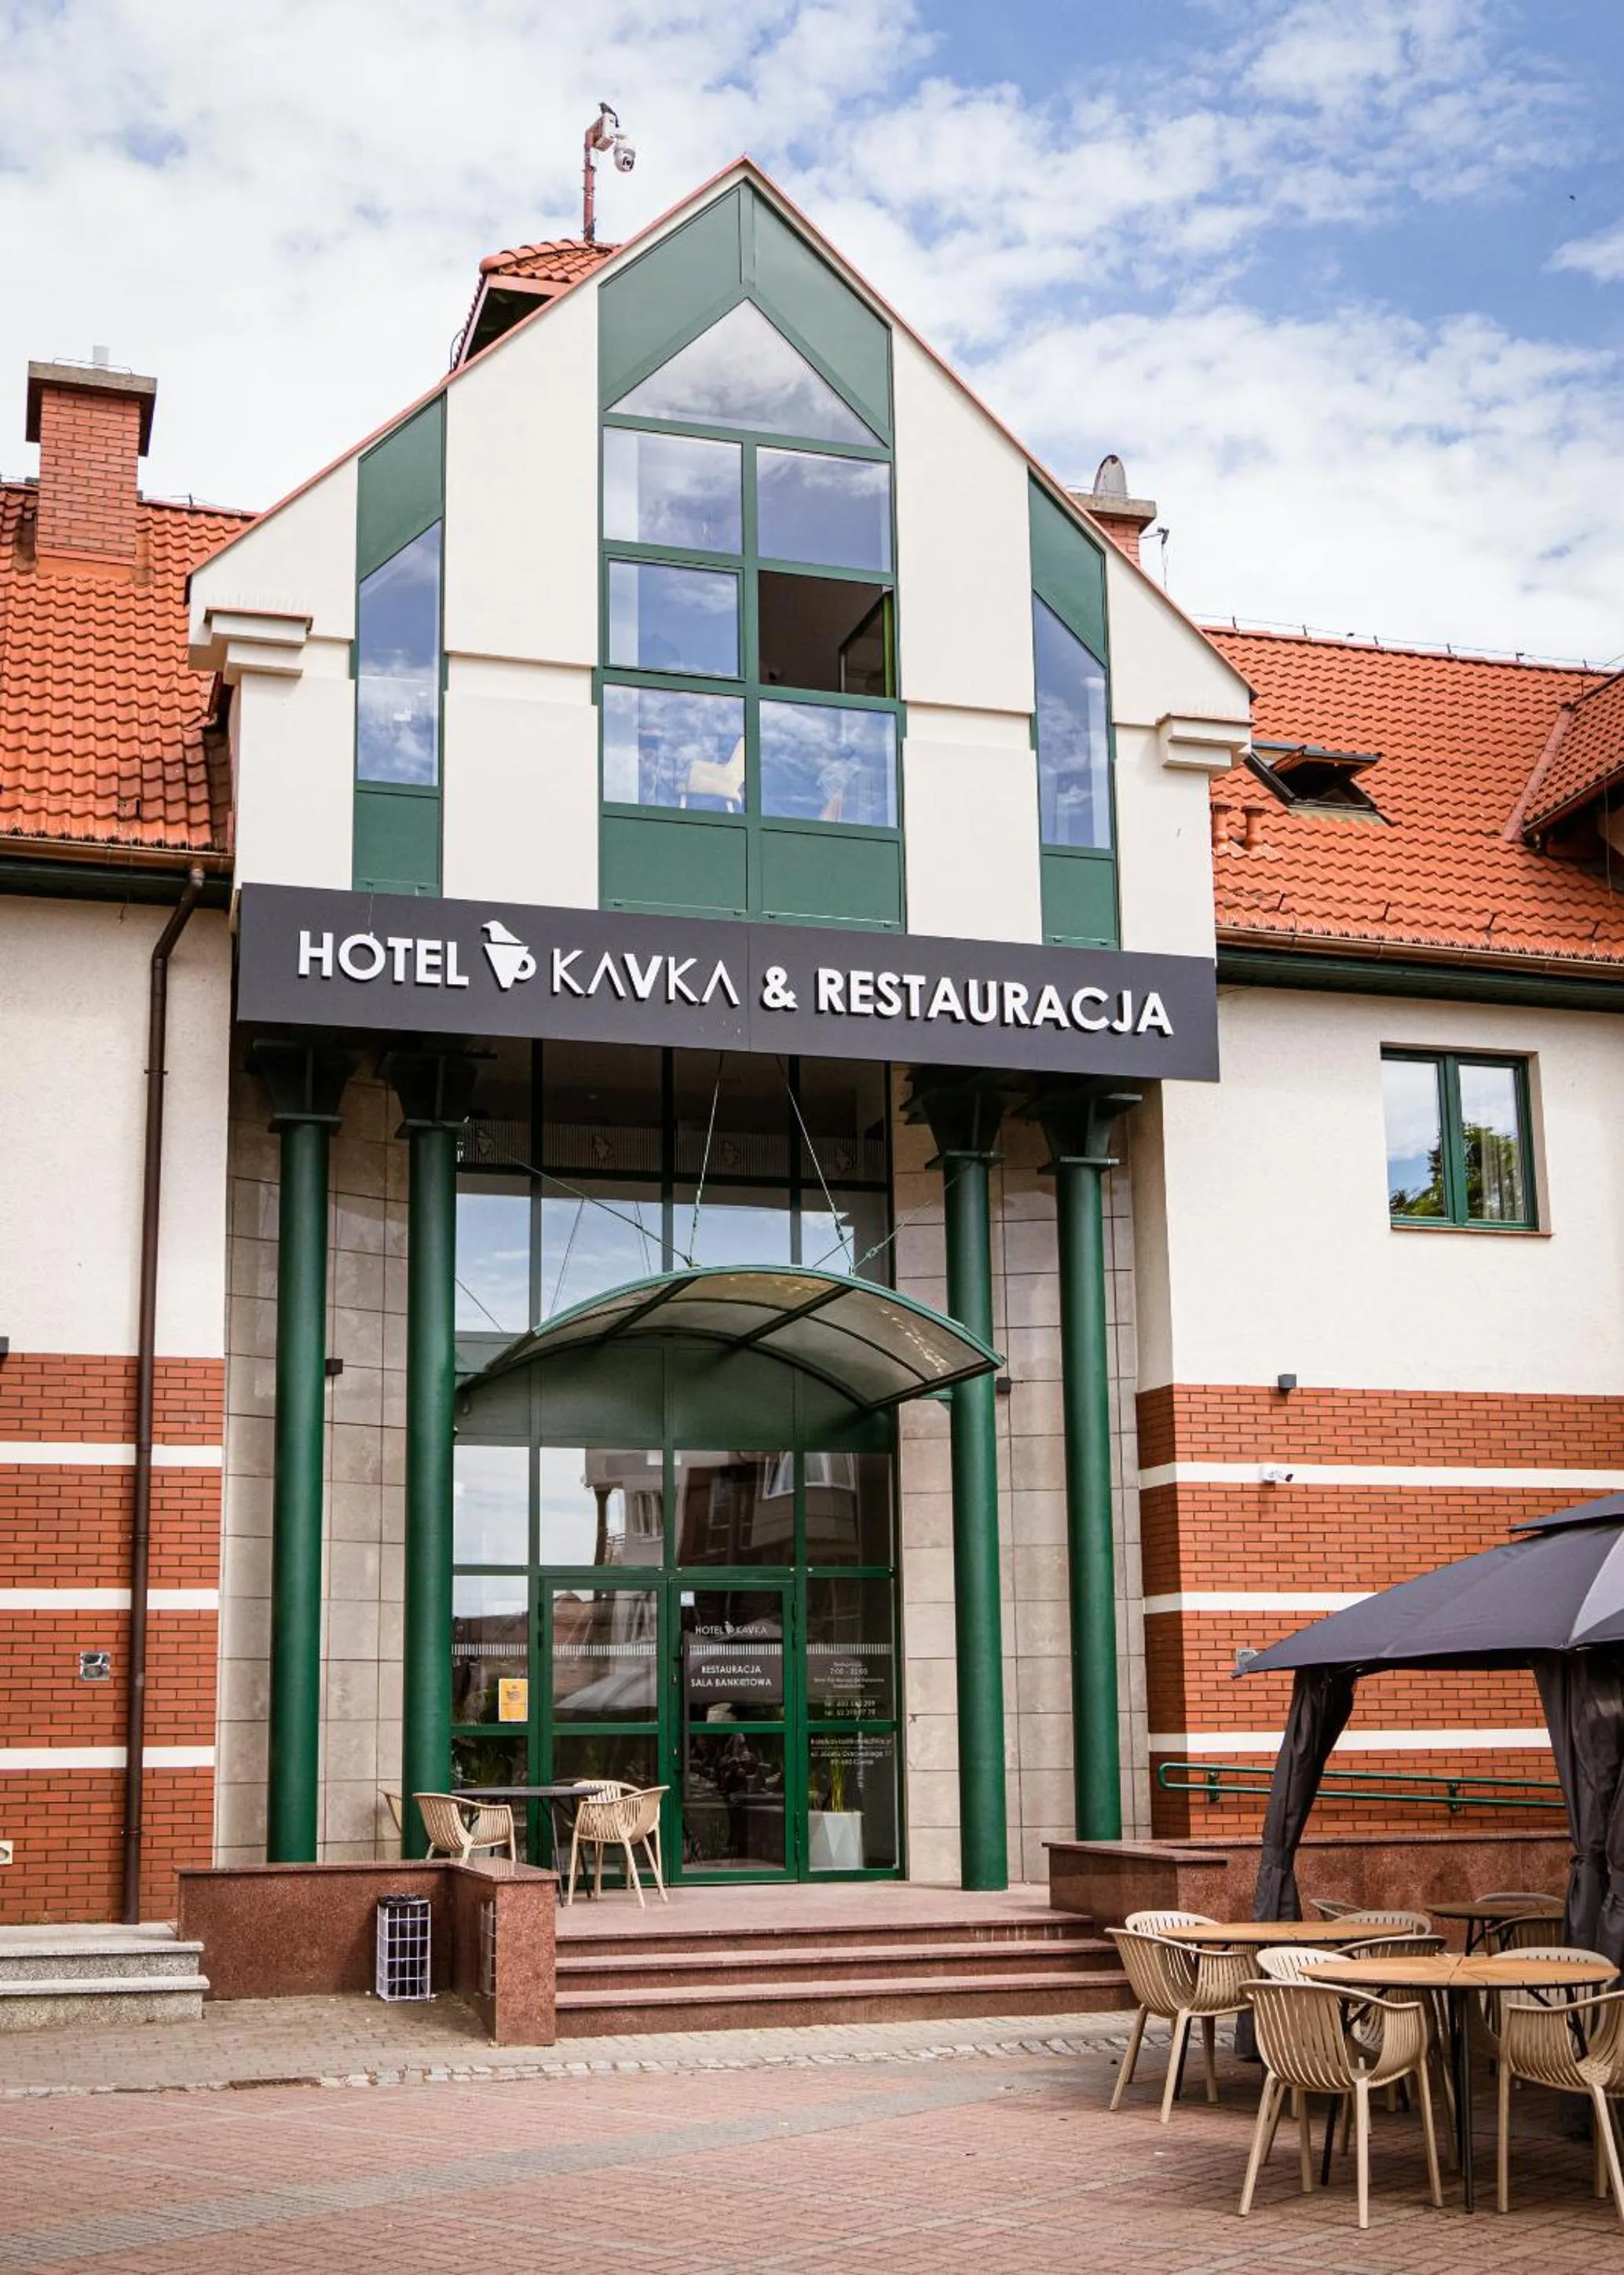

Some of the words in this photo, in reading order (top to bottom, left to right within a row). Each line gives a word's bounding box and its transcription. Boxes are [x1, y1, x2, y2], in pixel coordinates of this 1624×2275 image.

[297, 930, 470, 987] HOTEL
[760, 965, 799, 1010] &
[816, 967, 1175, 1037] RESTAURACJA
[695, 1625, 724, 1635] HOTEL
[736, 1625, 767, 1635] KAVKA
[701, 1665, 762, 1674] RESTAURACJA
[691, 1678, 713, 1688] SALA
